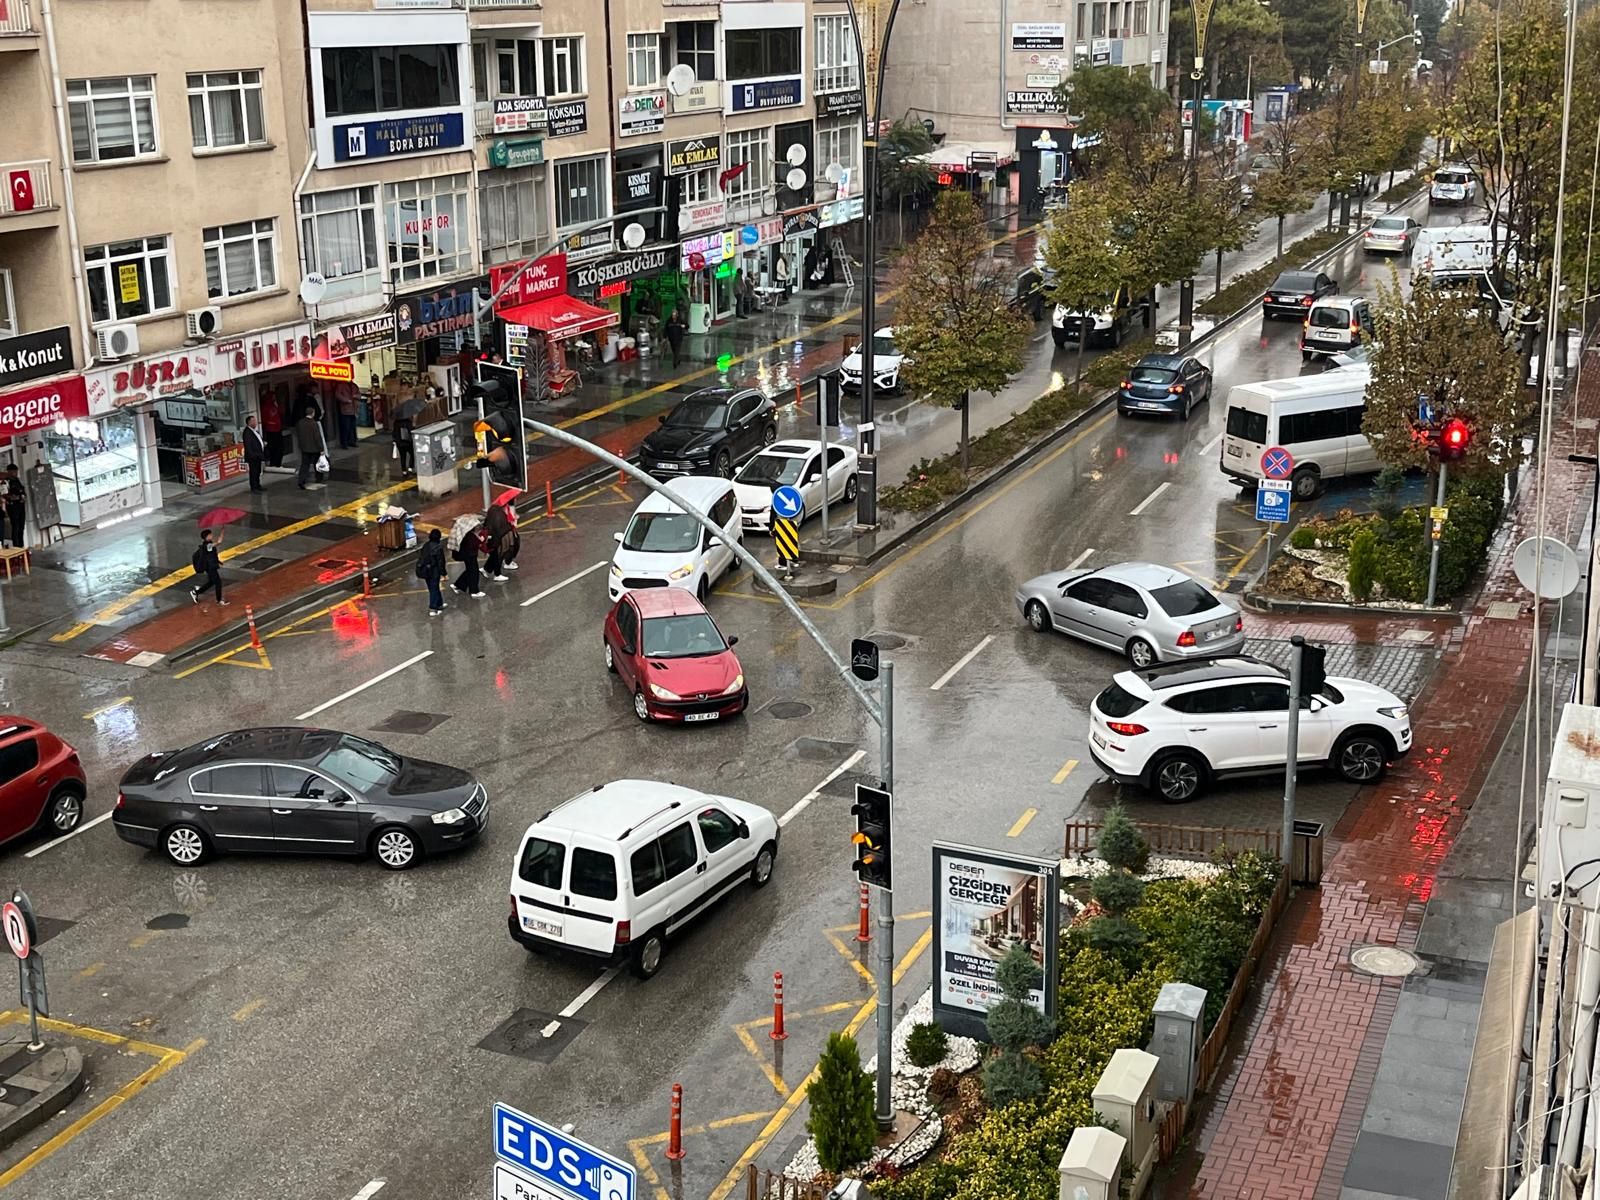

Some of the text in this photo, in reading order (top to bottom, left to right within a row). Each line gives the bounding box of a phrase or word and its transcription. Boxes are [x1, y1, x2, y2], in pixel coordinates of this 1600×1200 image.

[497, 98, 544, 112] ADA SİGORTA
[548, 104, 584, 121] KÖKSALDI
[376, 128, 400, 140] MALİ
[405, 122, 445, 138] MÜŞAVİR
[389, 135, 439, 152] BORA BATI
[671, 146, 718, 166] AK EMLAK
[525, 264, 547, 279] TUNÇ
[577, 251, 666, 287] KÖŞKEROĞLU
[526, 276, 560, 295] MARKET
[353, 317, 394, 337] AK EMLAK
[233, 335, 311, 373] GÜNEŞ
[113, 356, 190, 394] BÜŞRA
[329, 367, 349, 377] FOTO
[949, 875, 1011, 896] ÇİZGİDEN
[949, 886, 1007, 907] GERÇEĞE
[954, 954, 979, 965] DUVAR
[949, 977, 972, 989] ÖZEL
[502, 1116, 582, 1187] EDS
